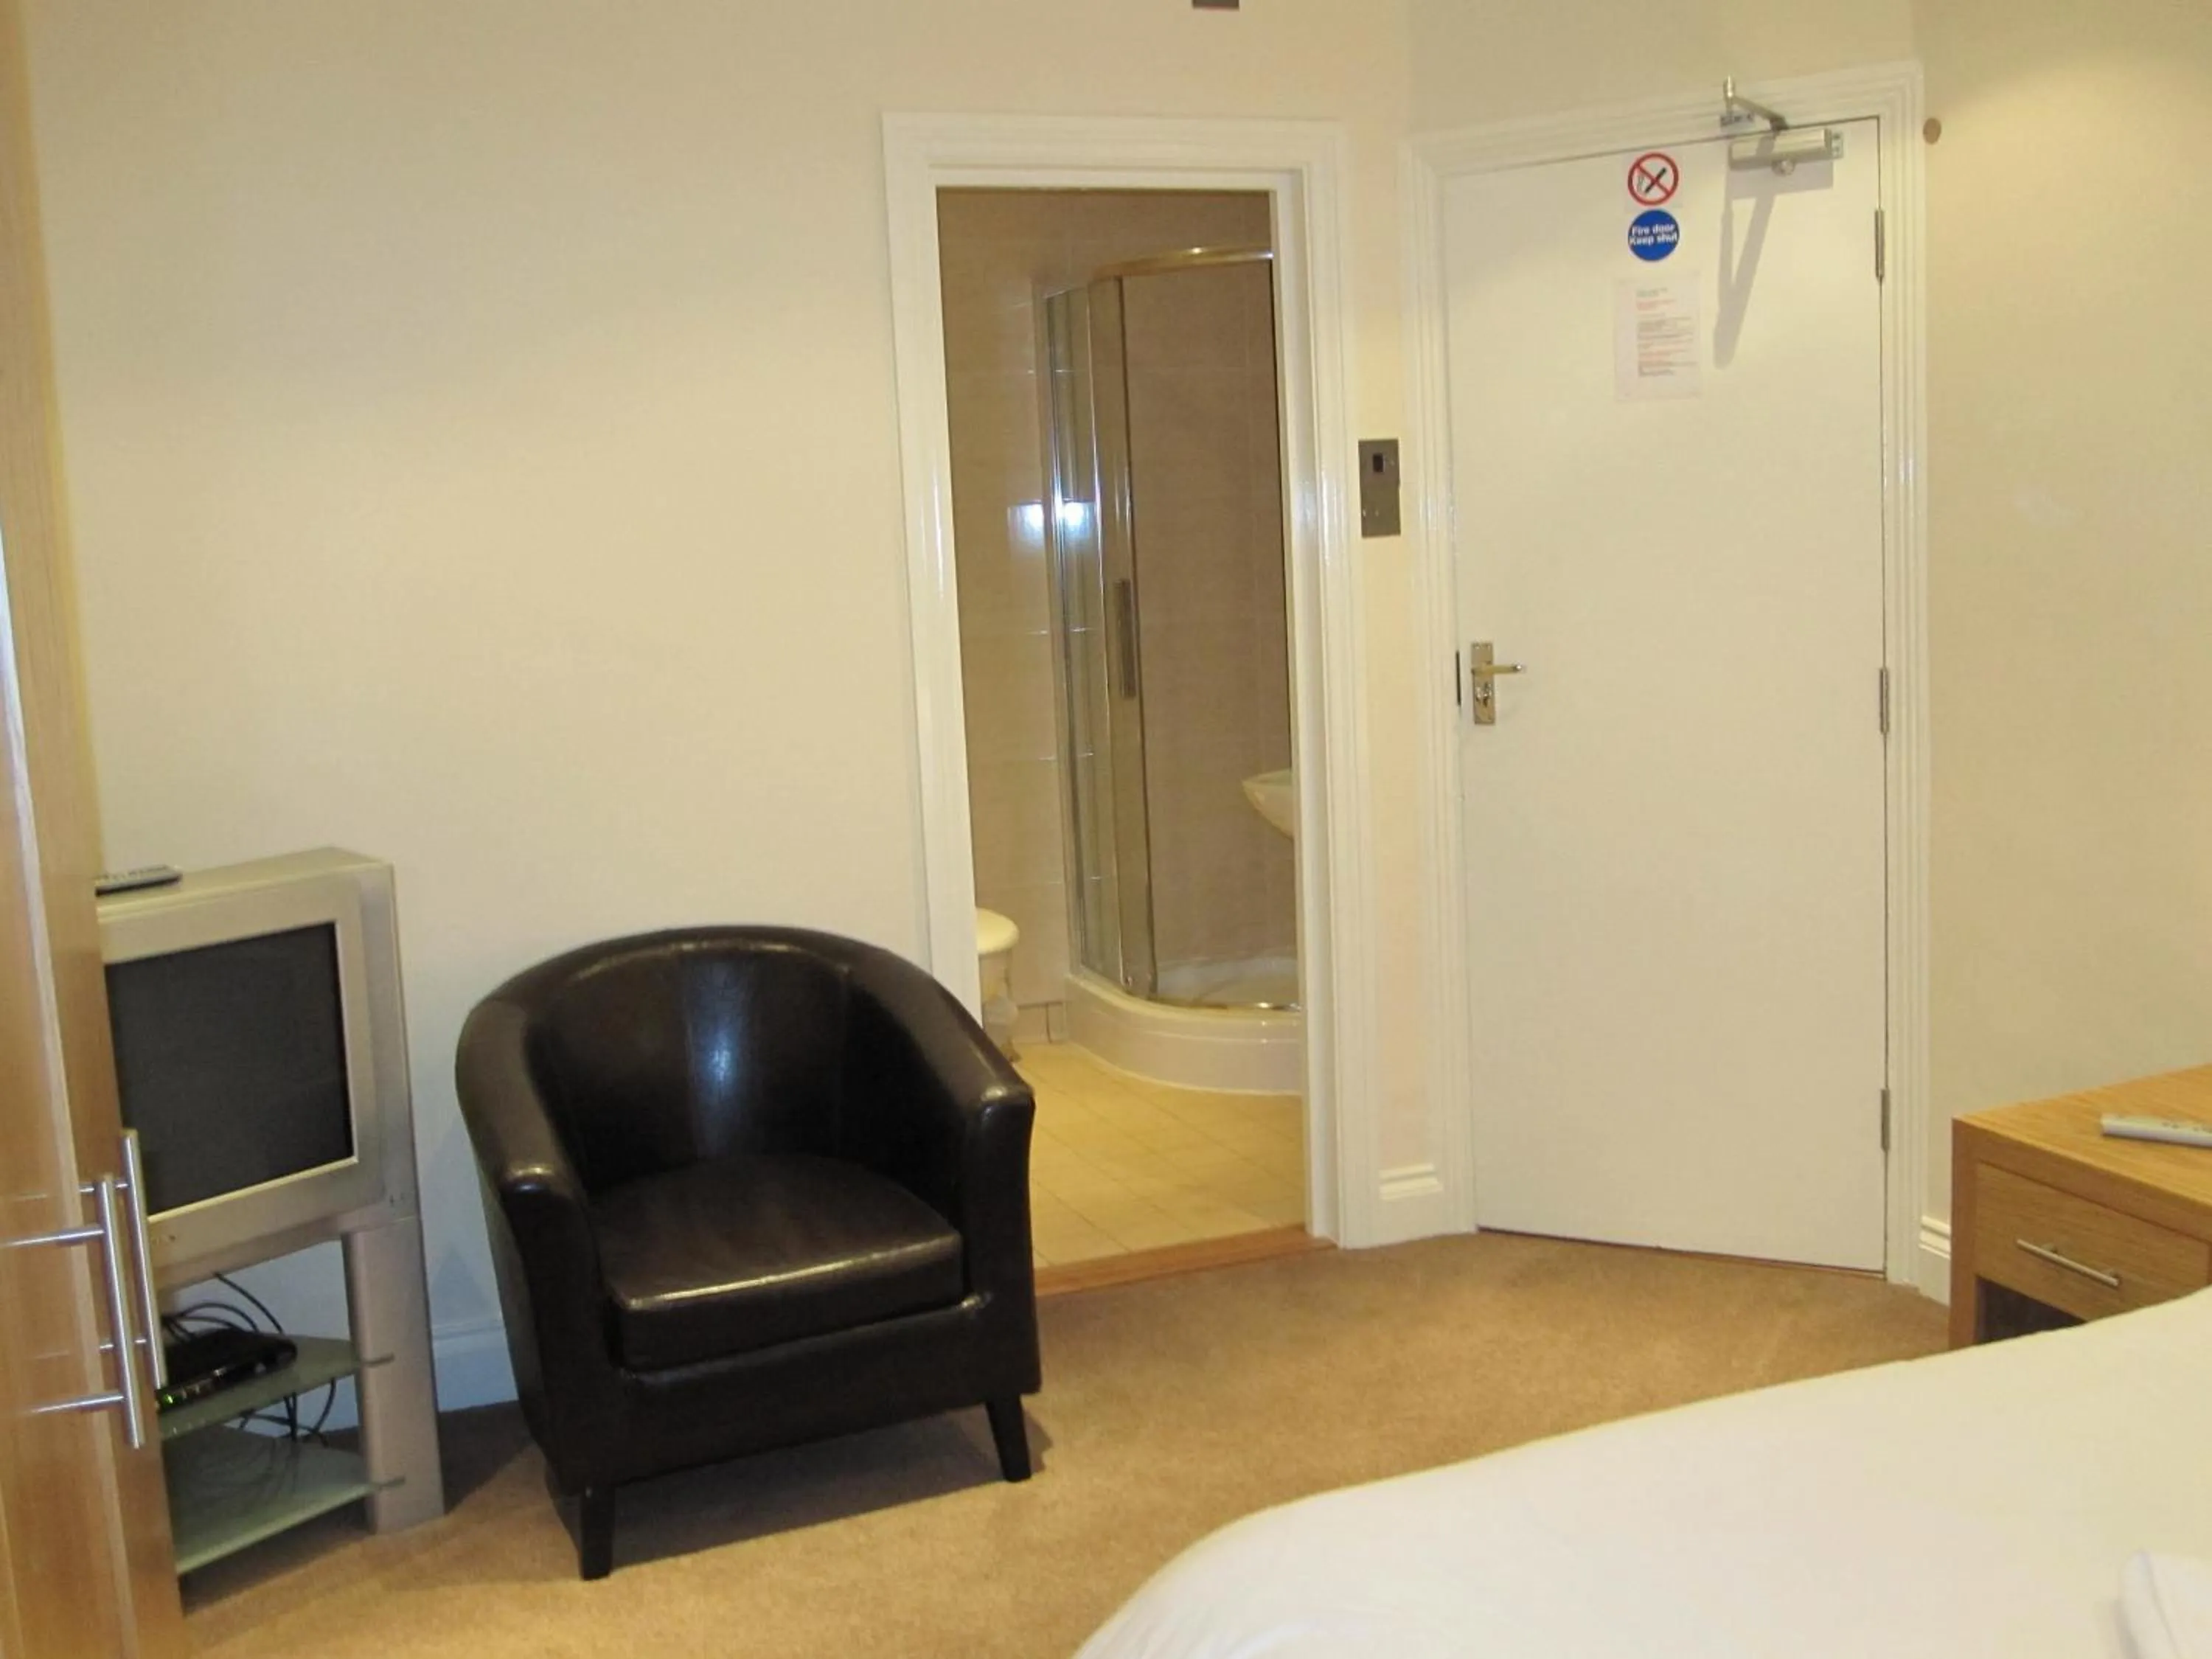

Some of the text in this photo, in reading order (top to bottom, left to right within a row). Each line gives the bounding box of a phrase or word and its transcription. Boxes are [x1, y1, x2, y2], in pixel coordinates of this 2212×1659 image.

[1631, 223, 1675, 236] Fire door
[1629, 232, 1677, 246] Keep shut
